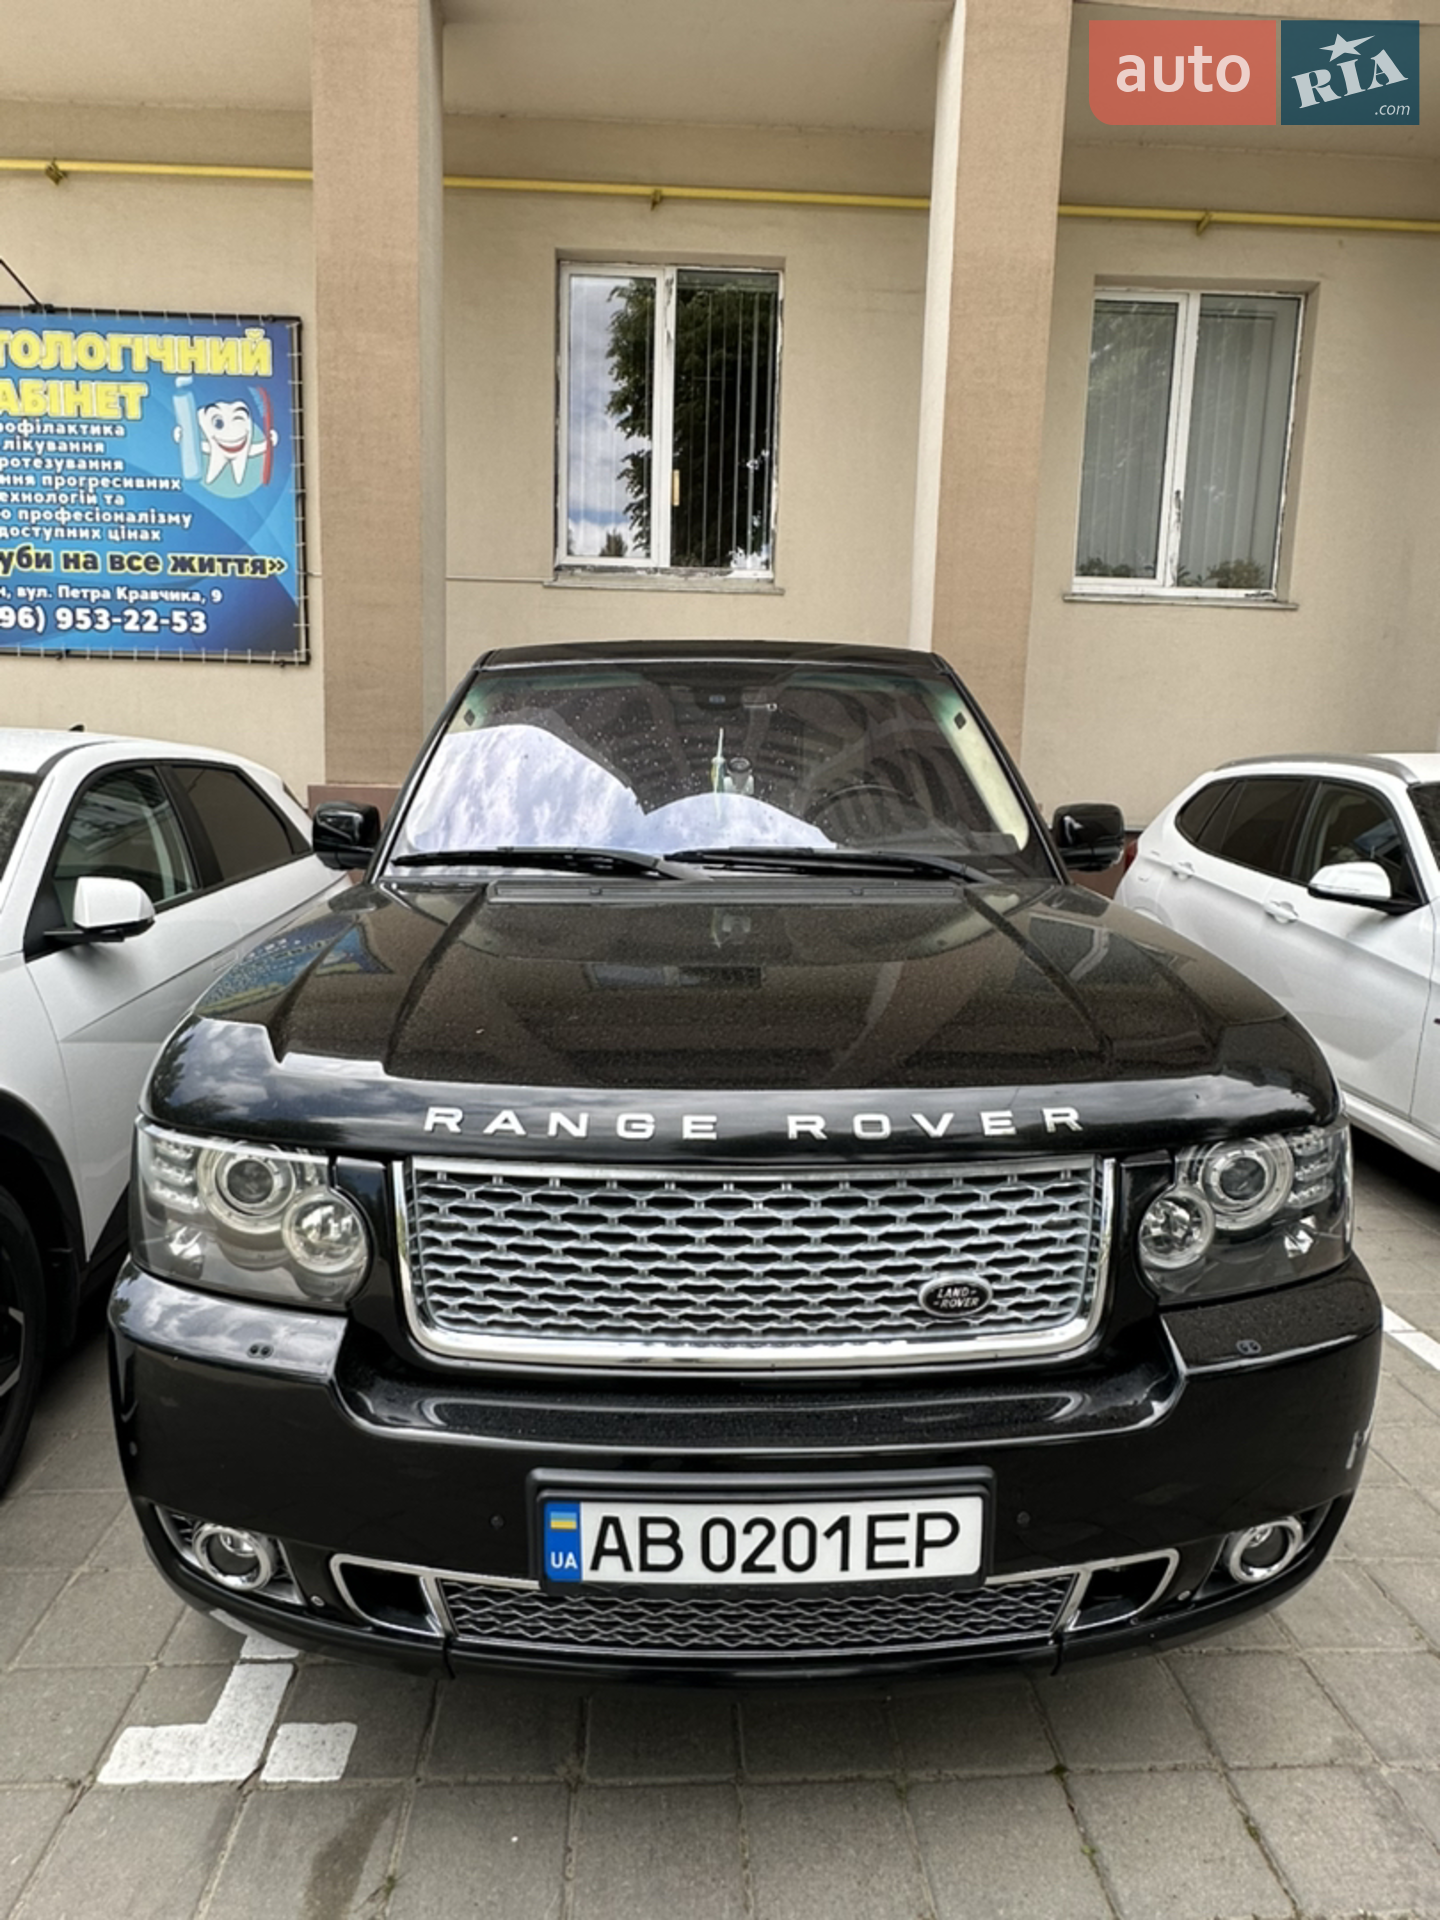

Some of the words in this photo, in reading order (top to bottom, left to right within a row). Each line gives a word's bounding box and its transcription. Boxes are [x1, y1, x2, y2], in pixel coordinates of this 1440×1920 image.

[3, 435, 104, 455] лікування
[42, 475, 181, 493] прогресивних
[103, 493, 125, 506] та
[18, 507, 192, 527] професіоналізму
[0, 526, 101, 541] доступних
[108, 526, 161, 542] цінах
[0, 544, 53, 575] уби
[63, 553, 99, 573] на
[108, 554, 161, 574] все
[168, 555, 286, 576] життя»
[17, 586, 52, 602] вул.
[58, 586, 111, 602] Петра
[116, 587, 207, 604] Кравчика,
[211, 591, 222, 603] 9
[55, 608, 207, 634] 953-22-53
[423, 1106, 718, 1140] RANGE
[786, 1106, 1084, 1141] ROVER
[590, 1515, 684, 1572] AB
[550, 1551, 578, 1569] UA
